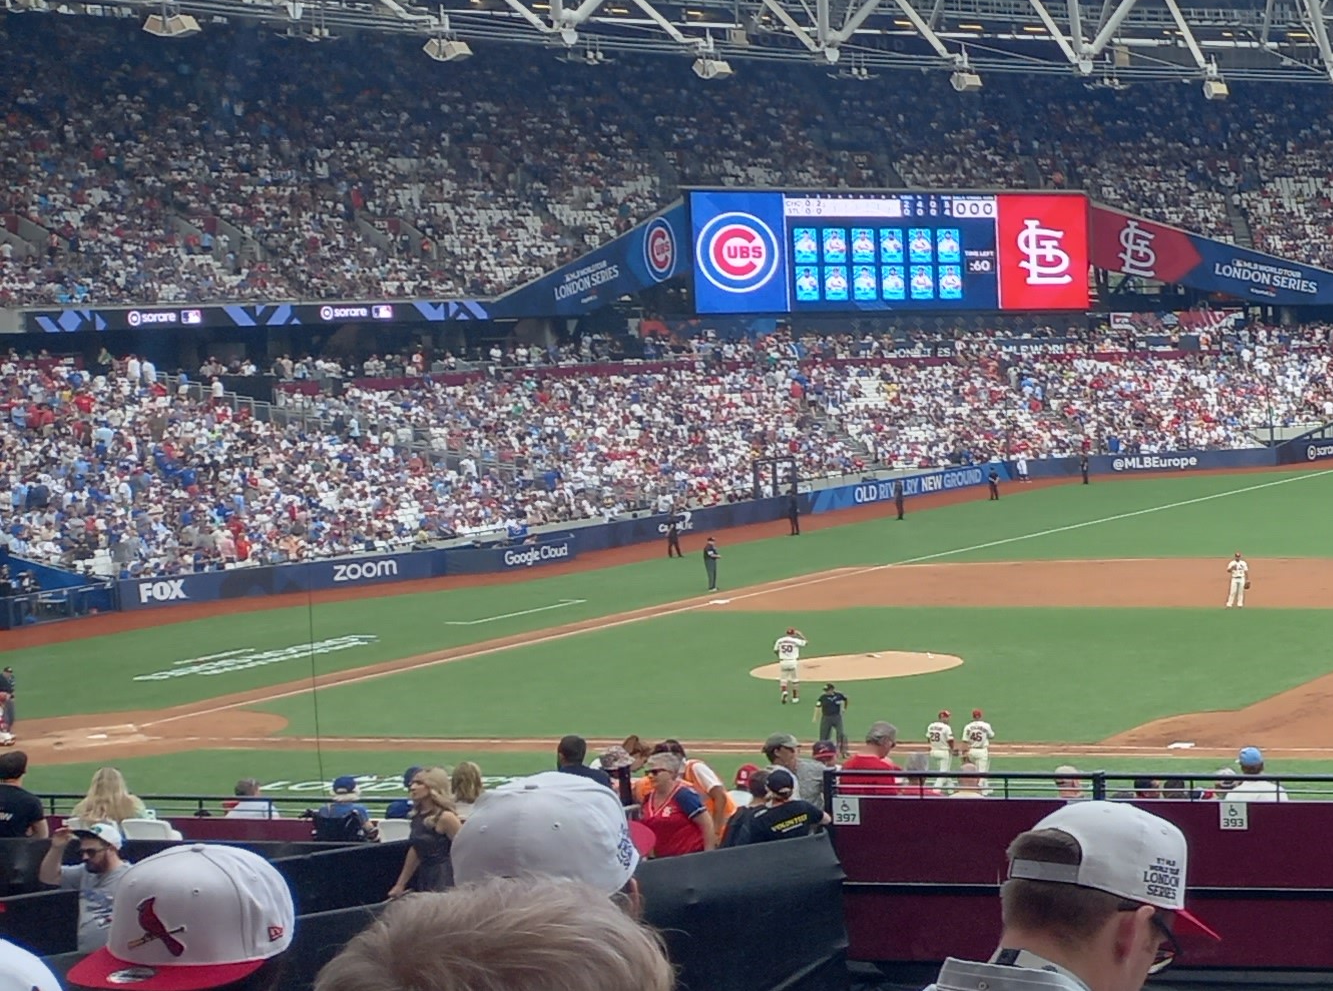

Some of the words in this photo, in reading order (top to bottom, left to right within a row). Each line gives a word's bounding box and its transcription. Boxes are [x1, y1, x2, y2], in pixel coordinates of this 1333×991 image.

[714, 227, 764, 277] CUBS
[554, 275, 592, 301] LONDON
[591, 265, 619, 286] SERIES
[1215, 262, 1271, 285] LONDON
[1272, 275, 1318, 294] SERIES
[141, 311, 176, 324] sorare
[333, 307, 368, 318] sorare
[1113, 456, 1197, 471] @MLBEurope
[854, 485, 877, 503] OLD
[880, 477, 919, 499] RIVLRY
[921, 474, 942, 492] NEW
[943, 470, 981, 488] GROUND
[505, 546, 540, 566] Google
[540, 543, 568, 558] Cloud
[333, 559, 397, 581] zoom
[139, 578, 188, 603] FOX
[781, 644, 793, 654] 50
[930, 731, 941, 742] 28
[970, 731, 983, 742] 46
[836, 813, 856, 823] 397
[1223, 818, 1244, 828] 393
[1143, 870, 1180, 888] LONDON
[1146, 884, 1177, 900] SERIES
